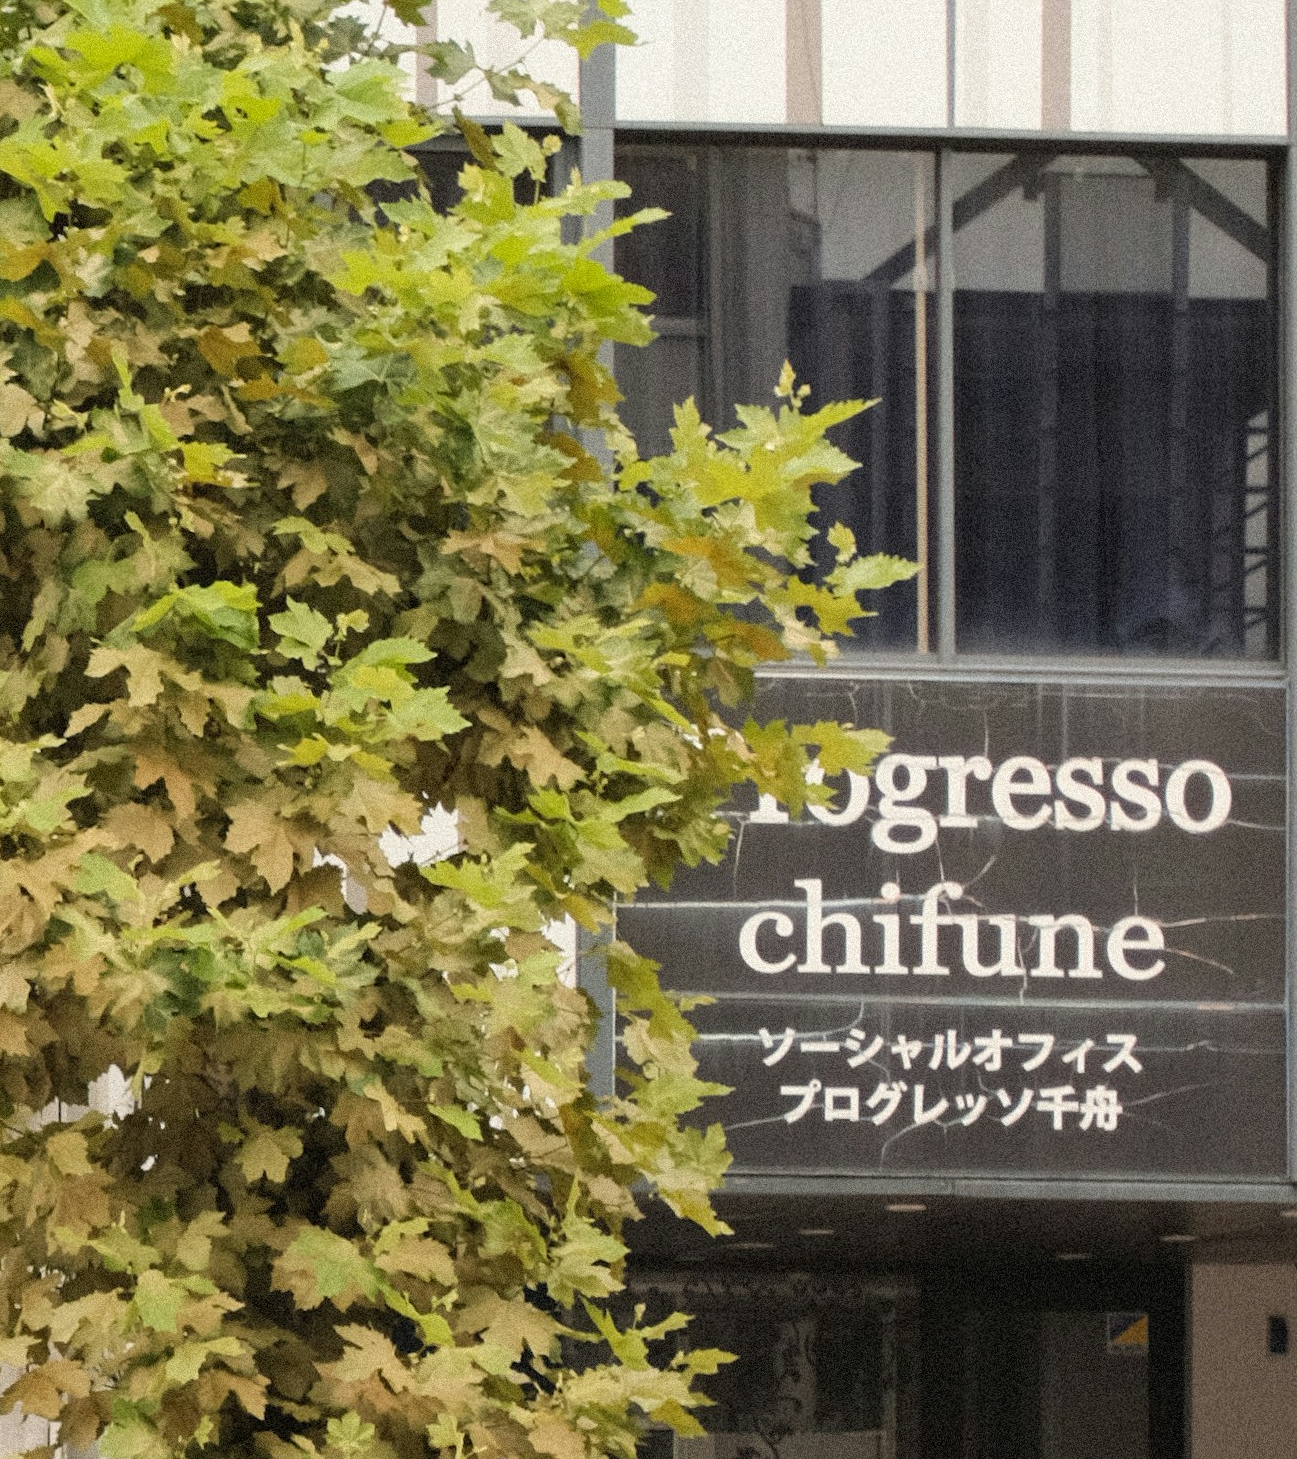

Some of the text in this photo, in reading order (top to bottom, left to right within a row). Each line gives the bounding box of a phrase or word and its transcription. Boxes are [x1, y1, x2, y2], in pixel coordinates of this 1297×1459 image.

[738, 879, 1166, 980] chifune
[758, 1027, 1143, 1074] ソーシャルオフィス
[779, 1079, 1124, 1132] プログレッソ千舟
